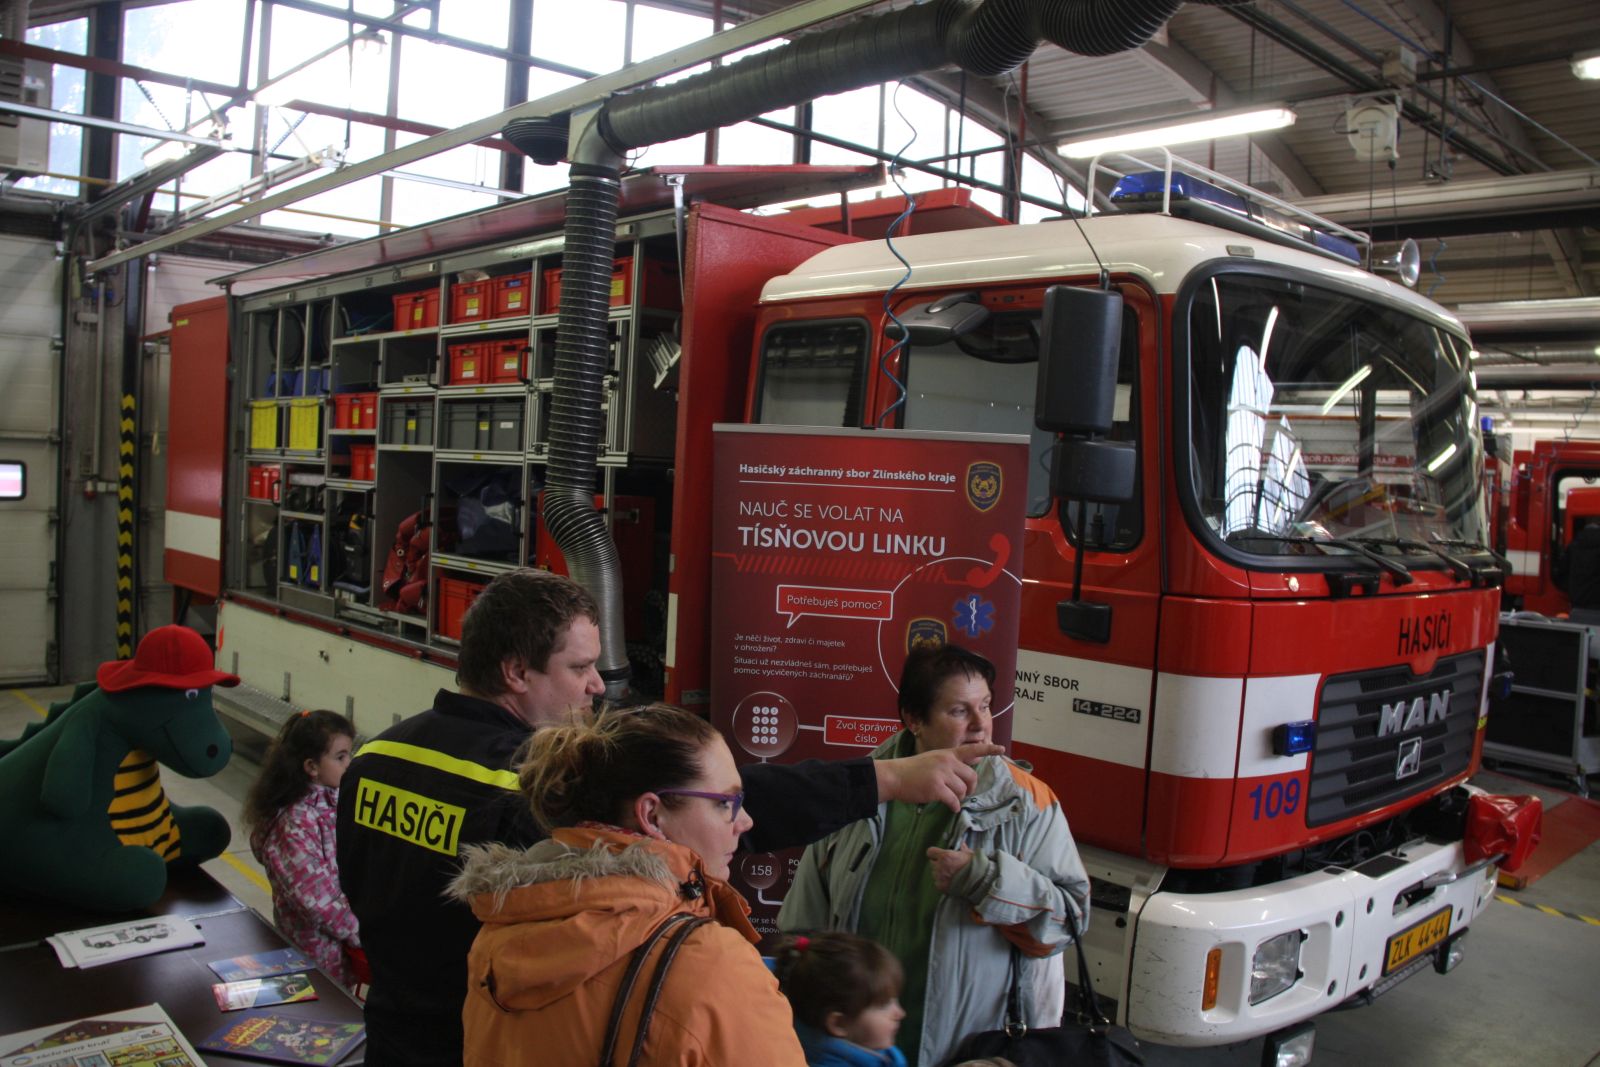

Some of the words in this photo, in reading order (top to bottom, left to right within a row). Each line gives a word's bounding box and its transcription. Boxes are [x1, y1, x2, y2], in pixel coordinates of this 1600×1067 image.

[739, 463, 785, 477] Hasičský
[788, 465, 844, 479] záchranný
[846, 468, 870, 479] sbor
[872, 469, 926, 481] Zlínského
[928, 471, 956, 485] kraje
[739, 499, 789, 518] NAUČ
[794, 503, 813, 519] SE
[818, 504, 875, 522] VOLAT
[879, 507, 904, 523] NA
[737, 522, 865, 553] TÍSŇOVOU
[872, 532, 946, 557] LINKU
[787, 594, 839, 608] Potřebuješ
[841, 599, 883, 610] pomoc?
[734, 633, 744, 641] Je
[816, 639, 846, 649] majetek
[1397, 609, 1452, 656] HASIČI
[733, 656, 758, 665] Situaci
[759, 658, 769, 666] už
[770, 658, 813, 668] nezvládneš
[832, 662, 873, 673] potřebuješ
[733, 668, 760, 676] pomoc
[1043, 675, 1079, 691] SBOR
[1377, 689, 1450, 738] MAN
[835, 719, 857, 730] Zvol
[859, 722, 898, 733] správné
[854, 733, 878, 744] číslo
[1249, 777, 1301, 821] 109
[358, 786, 457, 851] HASIČI
[750, 865, 773, 876] 158
[1390, 932, 1414, 965] ZLK
